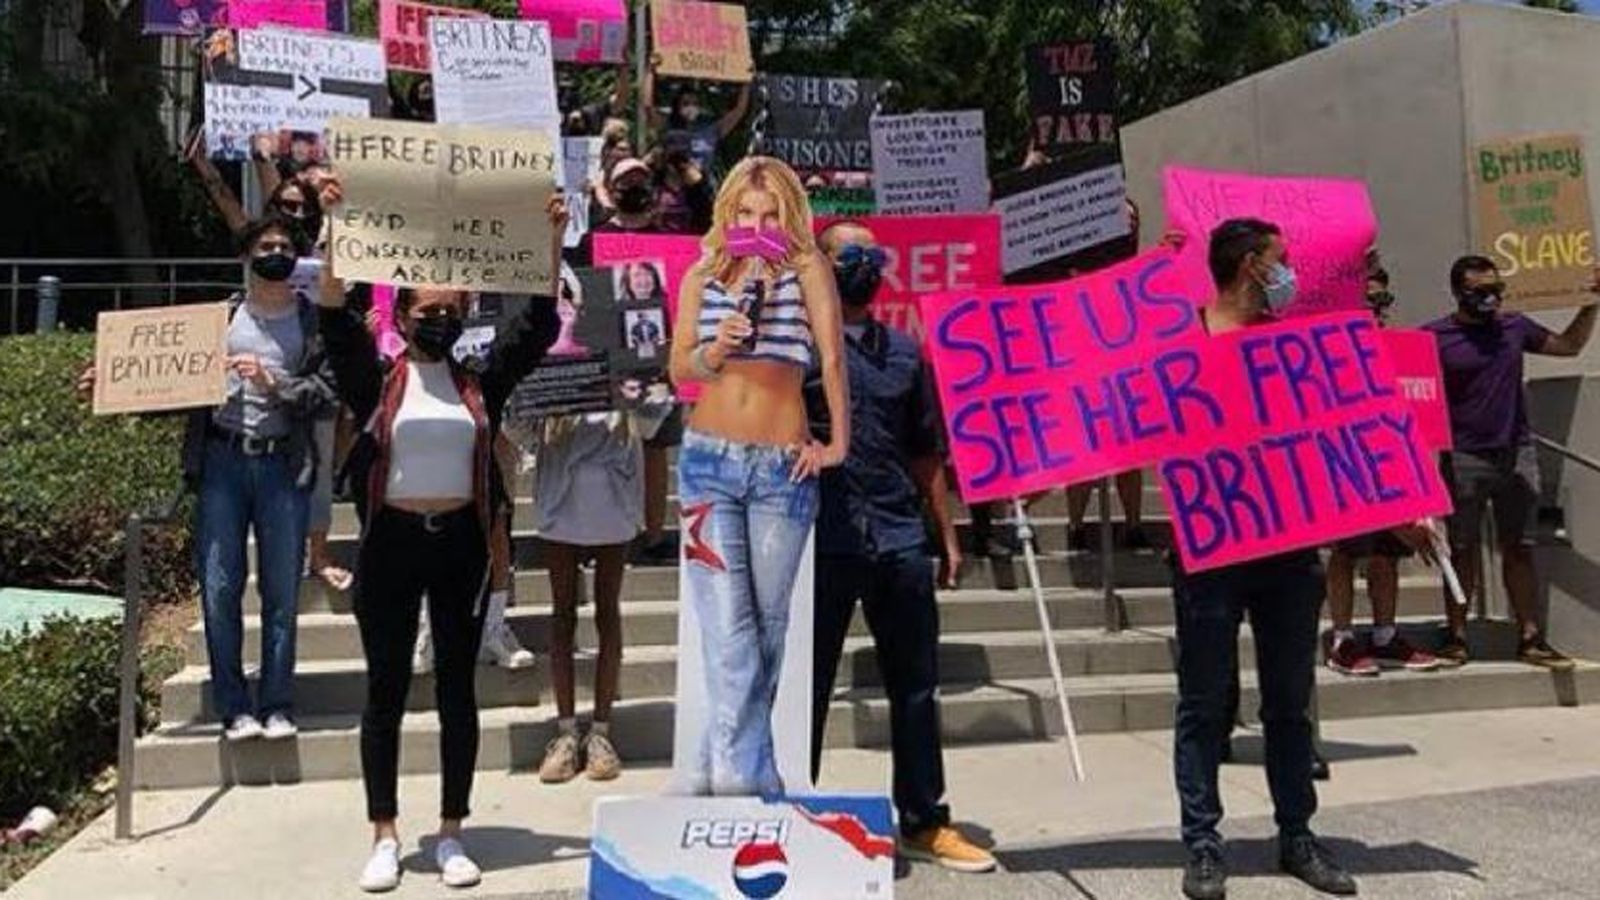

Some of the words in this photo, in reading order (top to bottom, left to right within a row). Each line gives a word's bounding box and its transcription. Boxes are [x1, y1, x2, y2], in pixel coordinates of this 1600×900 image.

[1044, 44, 1098, 75] TMZ
[1058, 76, 1084, 105] IS
[815, 107, 832, 133] A
[873, 116, 958, 129] INVESTIGATE
[931, 129, 983, 141] TAYLOR
[1036, 112, 1116, 146] FAKE
[763, 138, 871, 167] PRISONE
[1480, 143, 1581, 182] Britney
[344, 209, 406, 230] END
[453, 219, 505, 238] HER
[880, 241, 977, 292] REE
[1495, 230, 1595, 276] SLAVE
[391, 265, 496, 284] ABUSE
[129, 320, 188, 348] FREE
[937, 294, 1074, 392] SEE
[1077, 257, 1196, 350] US
[111, 351, 213, 383] BRITNEY
[952, 391, 1075, 489] SEE
[1072, 351, 1225, 452] HER
[1240, 320, 1395, 425] FREE
[1161, 412, 1430, 559] BRITNEY
[682, 819, 790, 849] PEPSI
